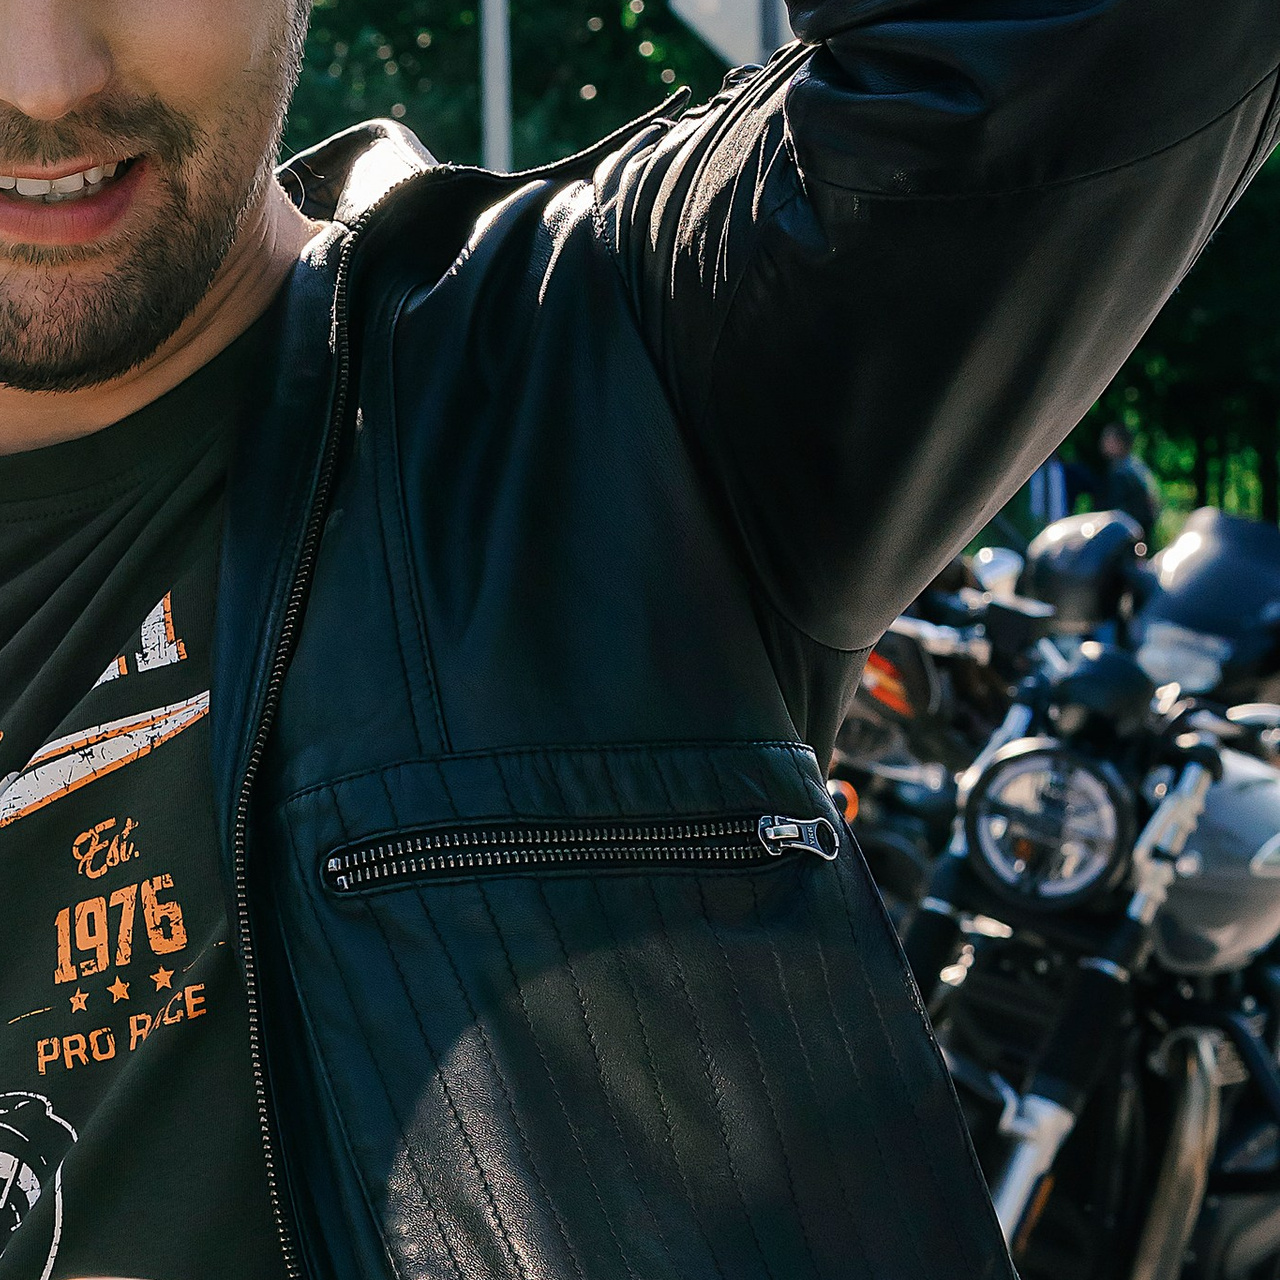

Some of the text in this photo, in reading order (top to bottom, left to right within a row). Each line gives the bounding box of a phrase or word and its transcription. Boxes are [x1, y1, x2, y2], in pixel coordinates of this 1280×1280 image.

[72, 817, 140, 880] Est.
[54, 873, 188, 985] 1976
[37, 1026, 116, 1076] PRO
